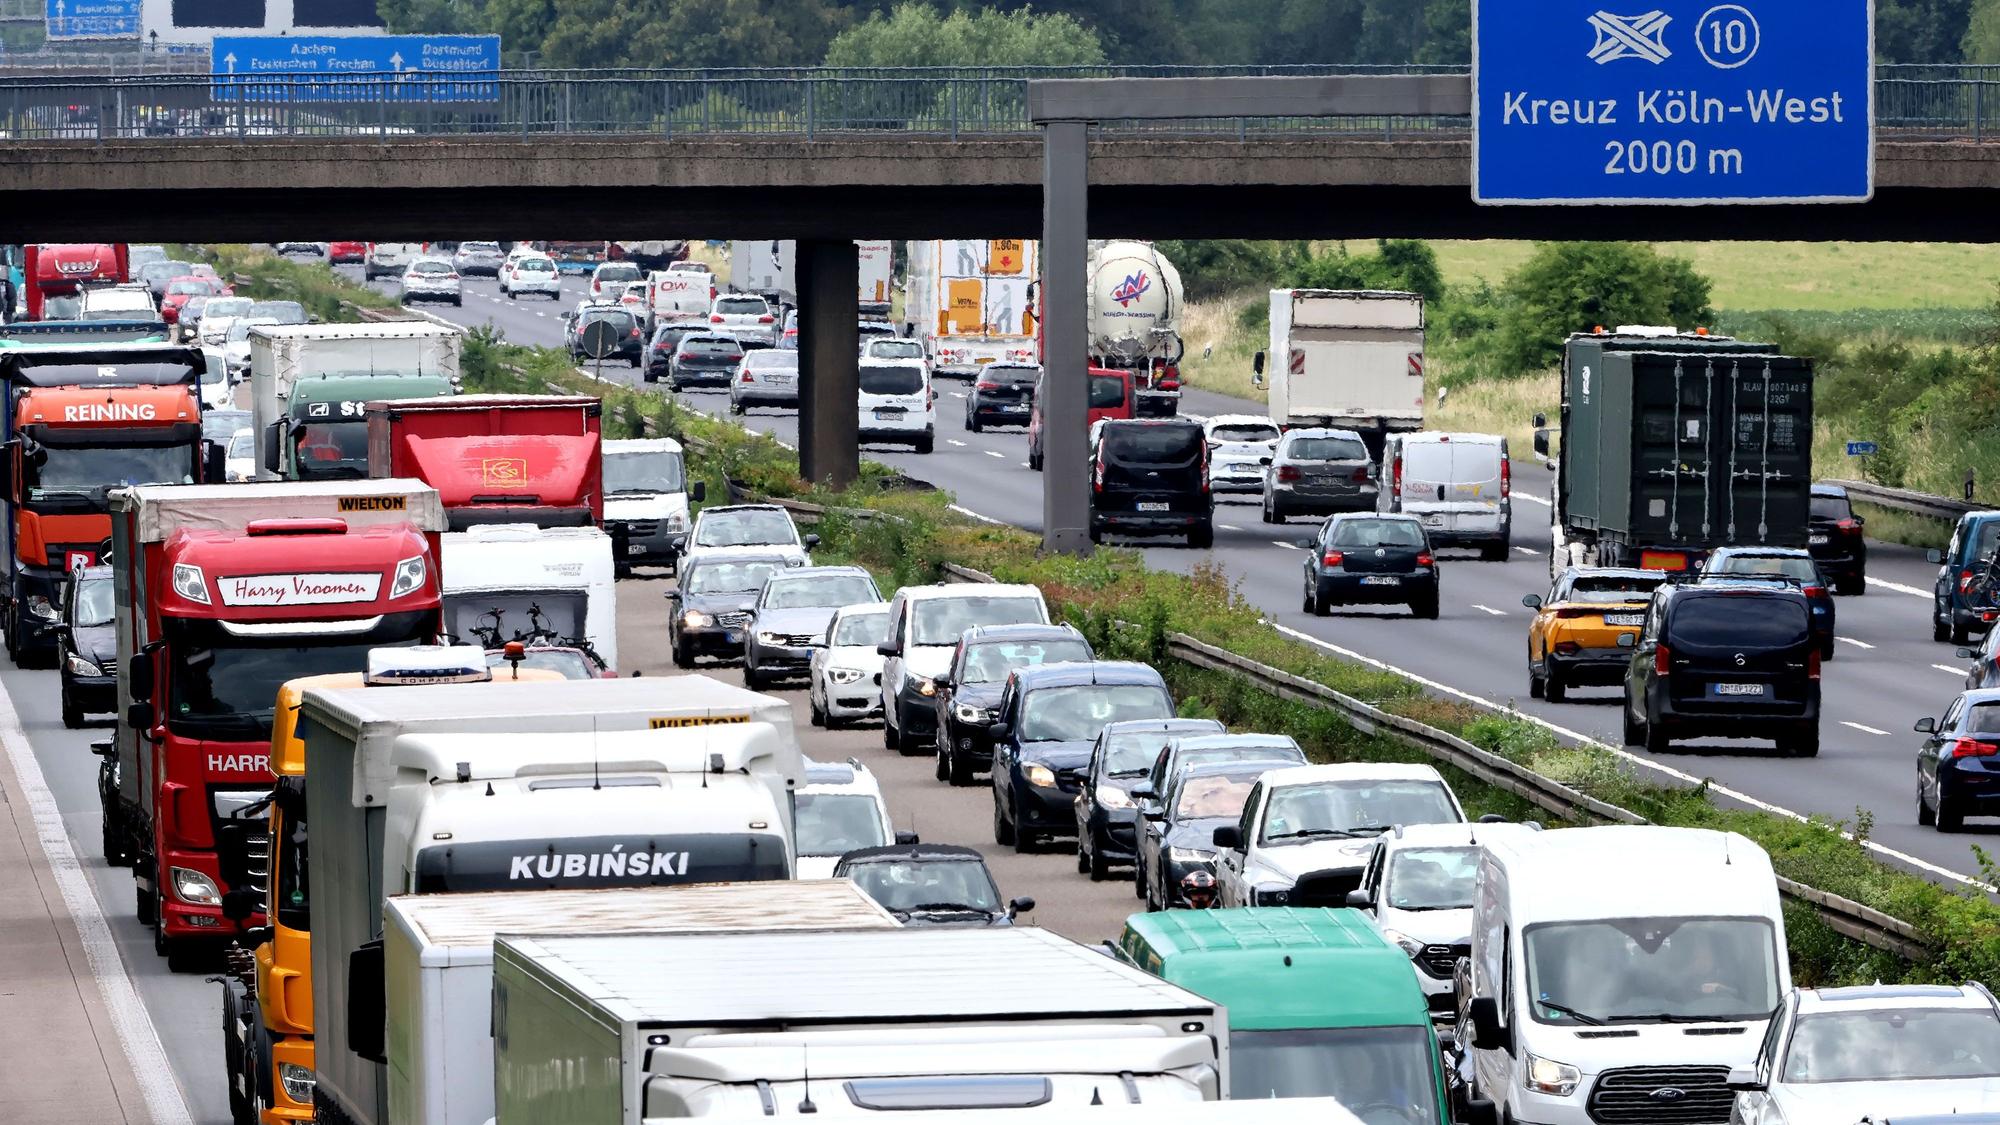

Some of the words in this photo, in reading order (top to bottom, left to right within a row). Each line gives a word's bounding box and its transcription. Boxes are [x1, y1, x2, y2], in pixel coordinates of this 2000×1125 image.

[1710, 19, 1746, 54] 10
[291, 44, 336, 55] Aachen
[422, 44, 482, 55] Dortmund
[1503, 92, 1617, 125] Kreuz
[1638, 89, 1844, 124] Köln-West
[1604, 140, 1696, 175] 2000
[1708, 149, 1742, 175] m
[64, 403, 156, 421] REINING
[340, 400, 366, 417] St
[339, 496, 404, 511] WIELTON
[235, 579, 287, 603] Harry
[293, 576, 366, 596] Vroomen
[208, 754, 271, 772] HARR
[510, 844, 690, 880] KUBIŃSKI
